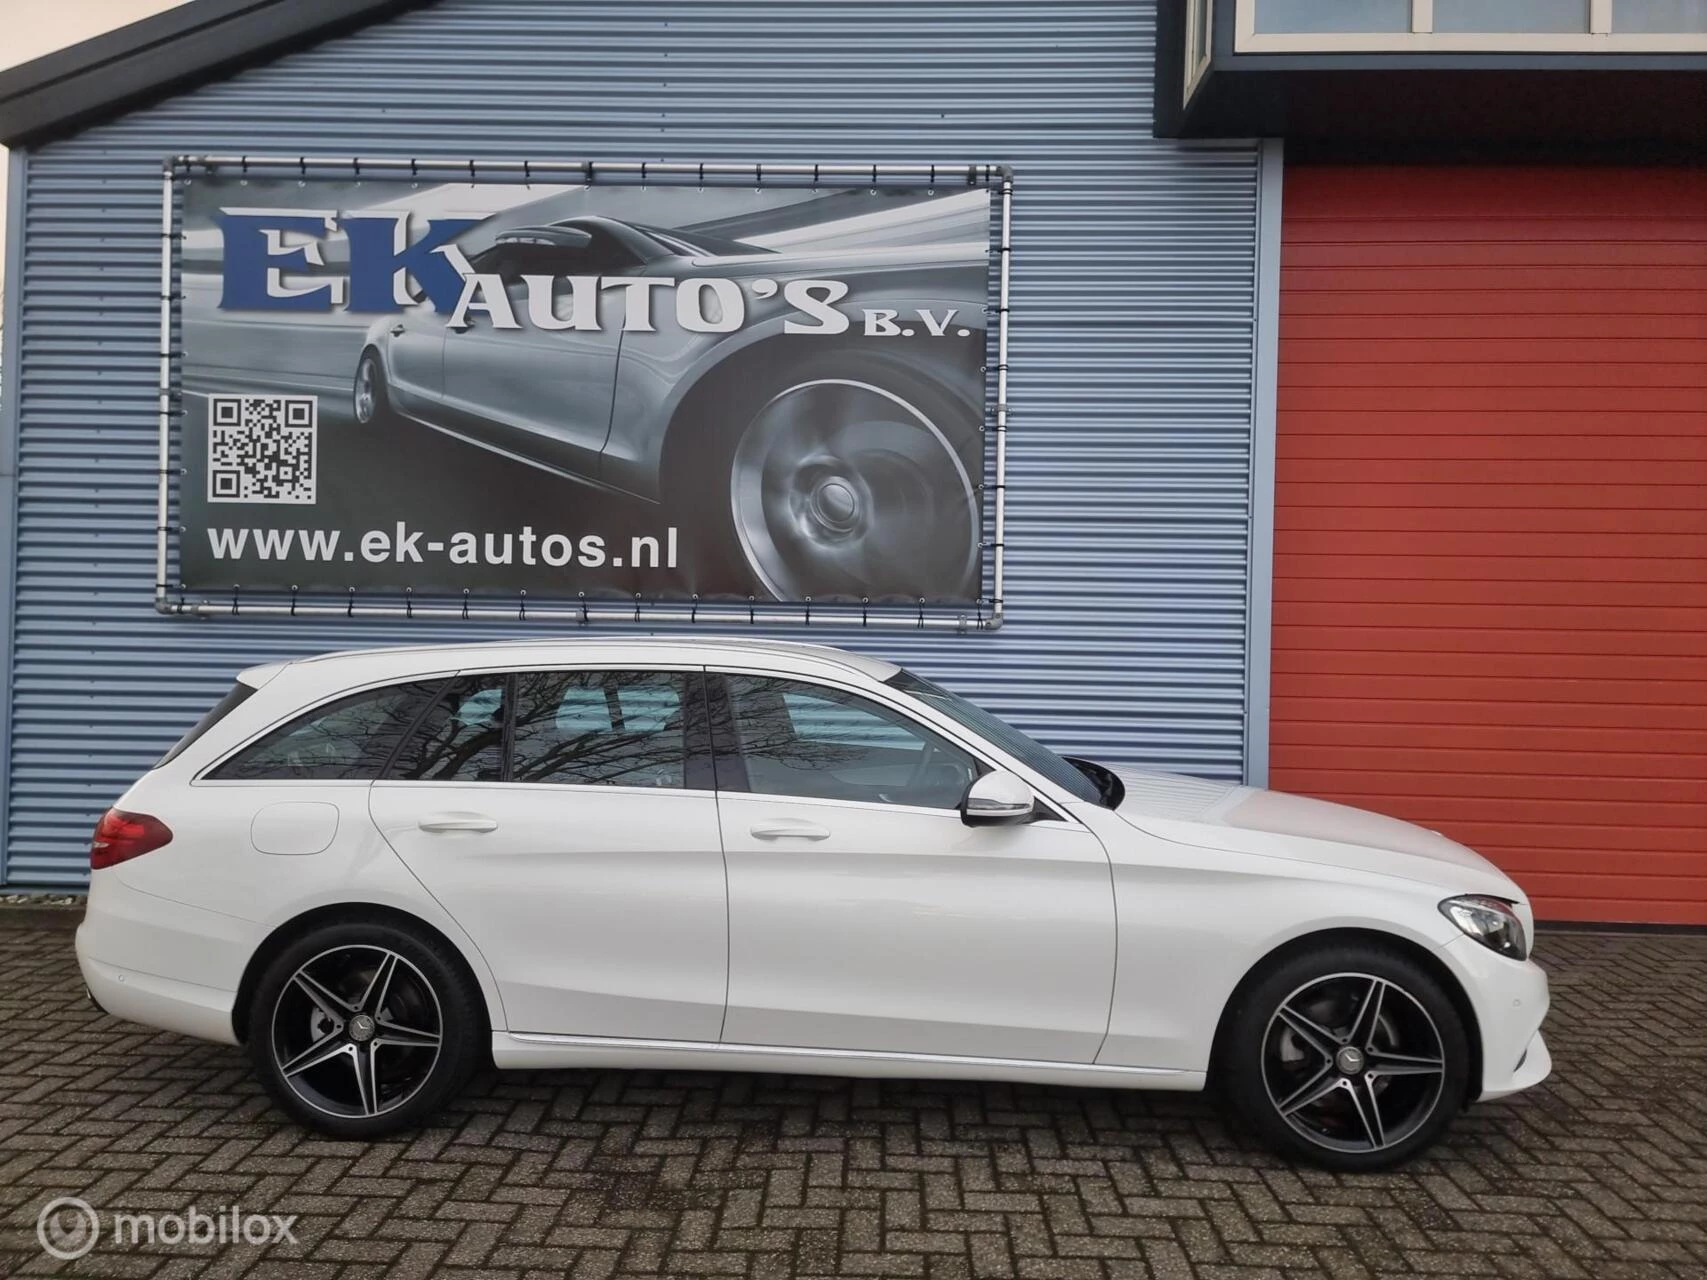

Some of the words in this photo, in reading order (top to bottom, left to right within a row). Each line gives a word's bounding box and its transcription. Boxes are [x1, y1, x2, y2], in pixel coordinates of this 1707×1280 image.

[219, 207, 492, 316] EK
[863, 308, 971, 337] B.V.
[207, 521, 678, 568] www.ek-autos.nl
